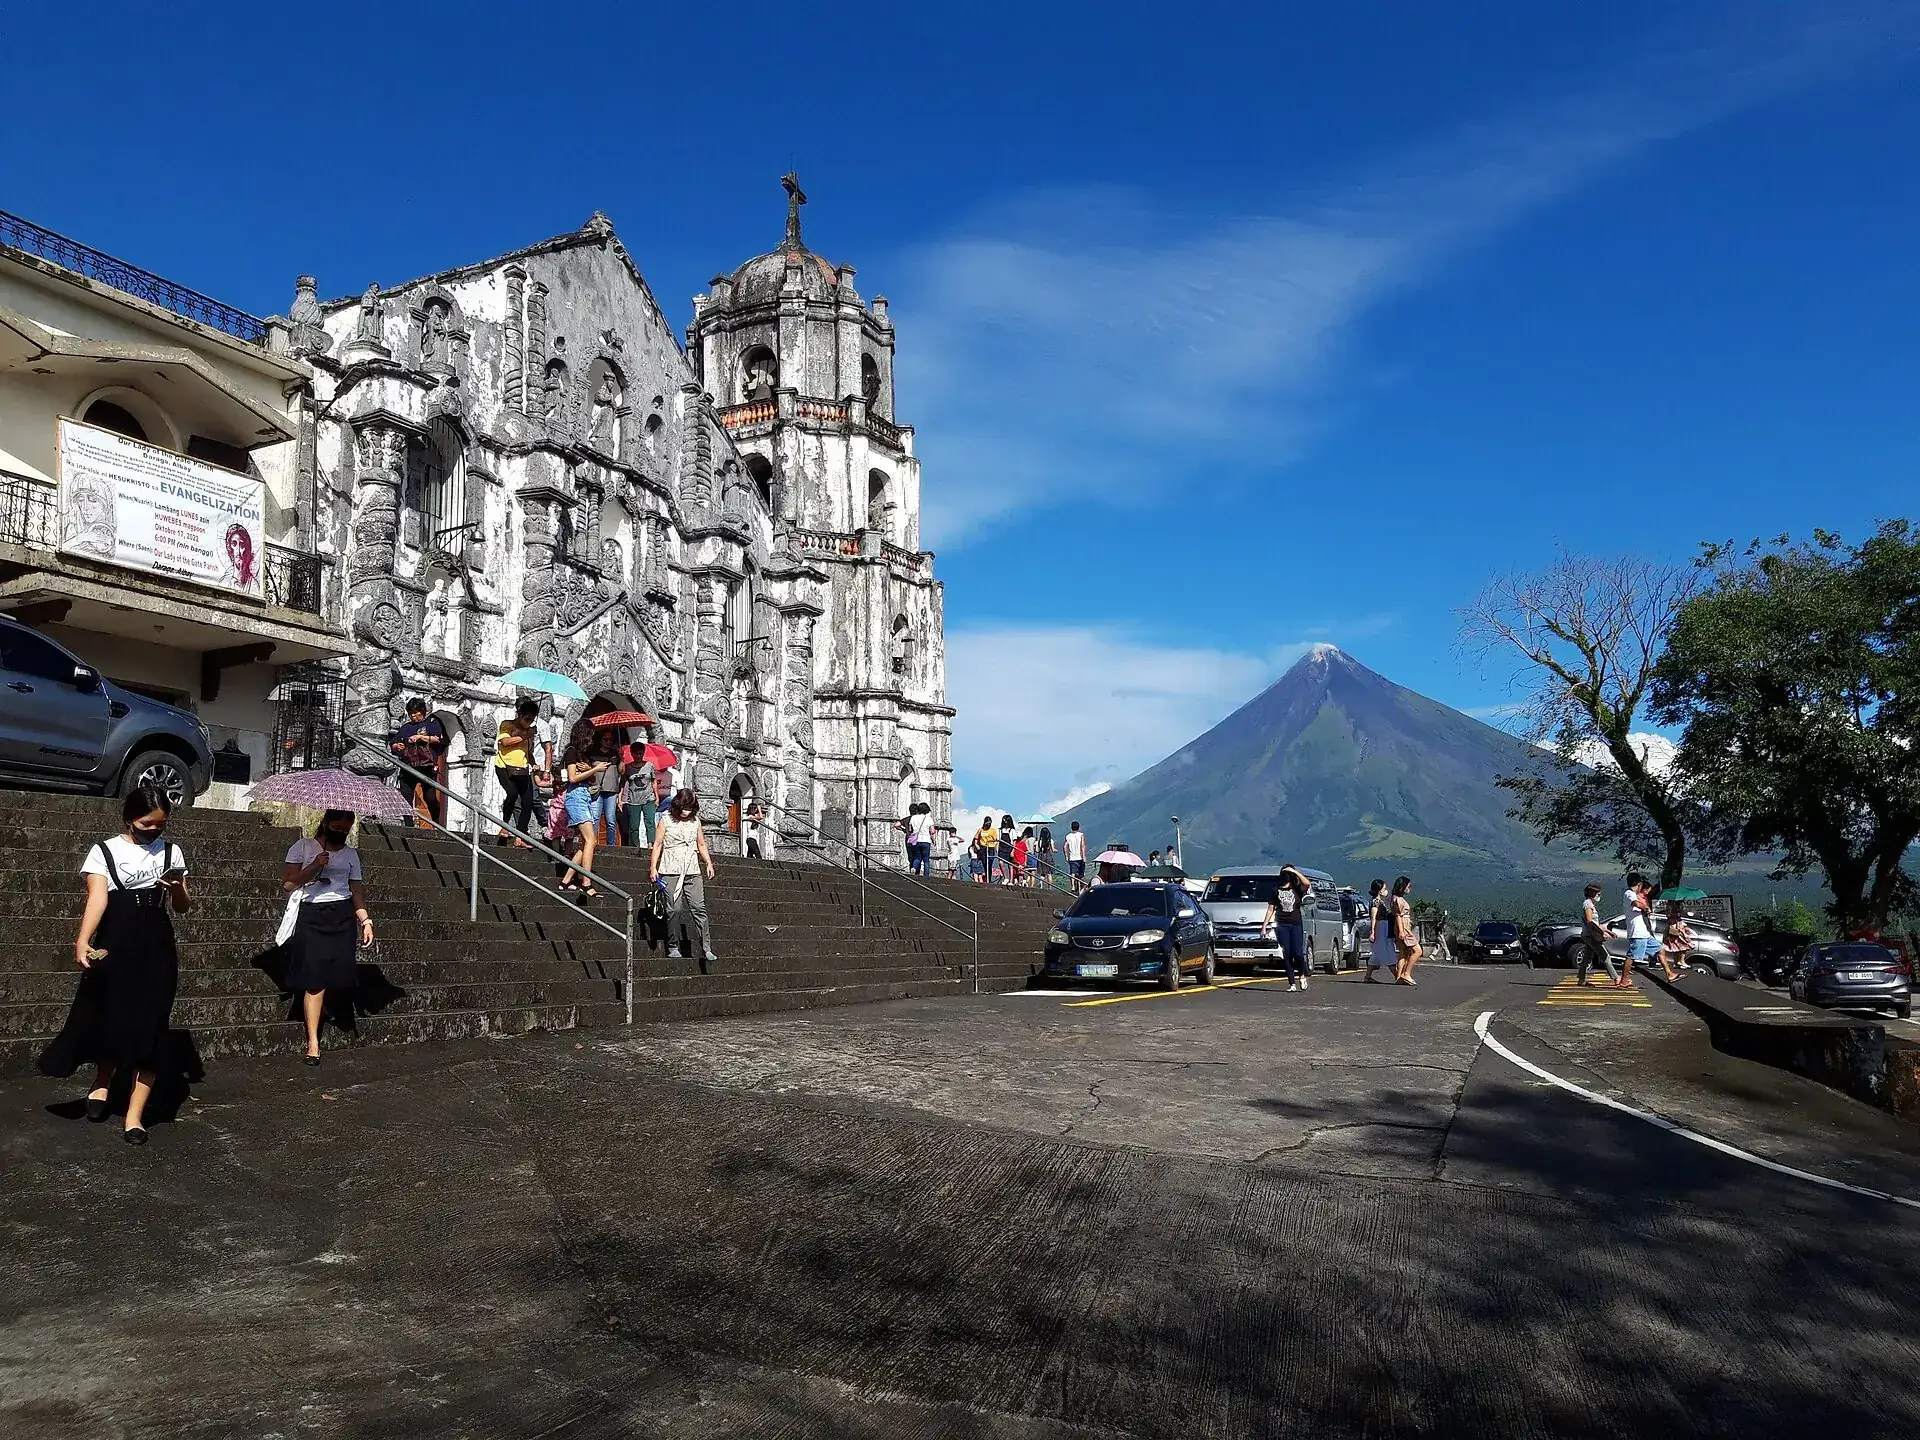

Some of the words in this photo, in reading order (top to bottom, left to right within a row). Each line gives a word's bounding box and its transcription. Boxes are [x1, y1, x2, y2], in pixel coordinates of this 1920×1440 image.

[117, 437, 130, 446] Our
[133, 442, 149, 453] Lady
[193, 461, 213, 472] Parish
[142, 452, 170, 466] Daraga,
[172, 461, 191, 472] Albay
[108, 471, 150, 489] HESUKRISTO
[160, 481, 259, 521] EVANGELIZATION
[154, 501, 179, 516] Lambang
[180, 509, 198, 521] LUNES
[199, 514, 209, 524] asin
[154, 512, 181, 526] HUWEBES
[154, 523, 176, 535] Oktobre
[186, 532, 199, 542] 2022
[154, 533, 166, 544] 6:00
[167, 537, 175, 546] PM
[118, 538, 135, 549] Where
[153, 547, 161, 557] Our
[163, 550, 175, 562] Lady
[203, 561, 218, 572] Parish
